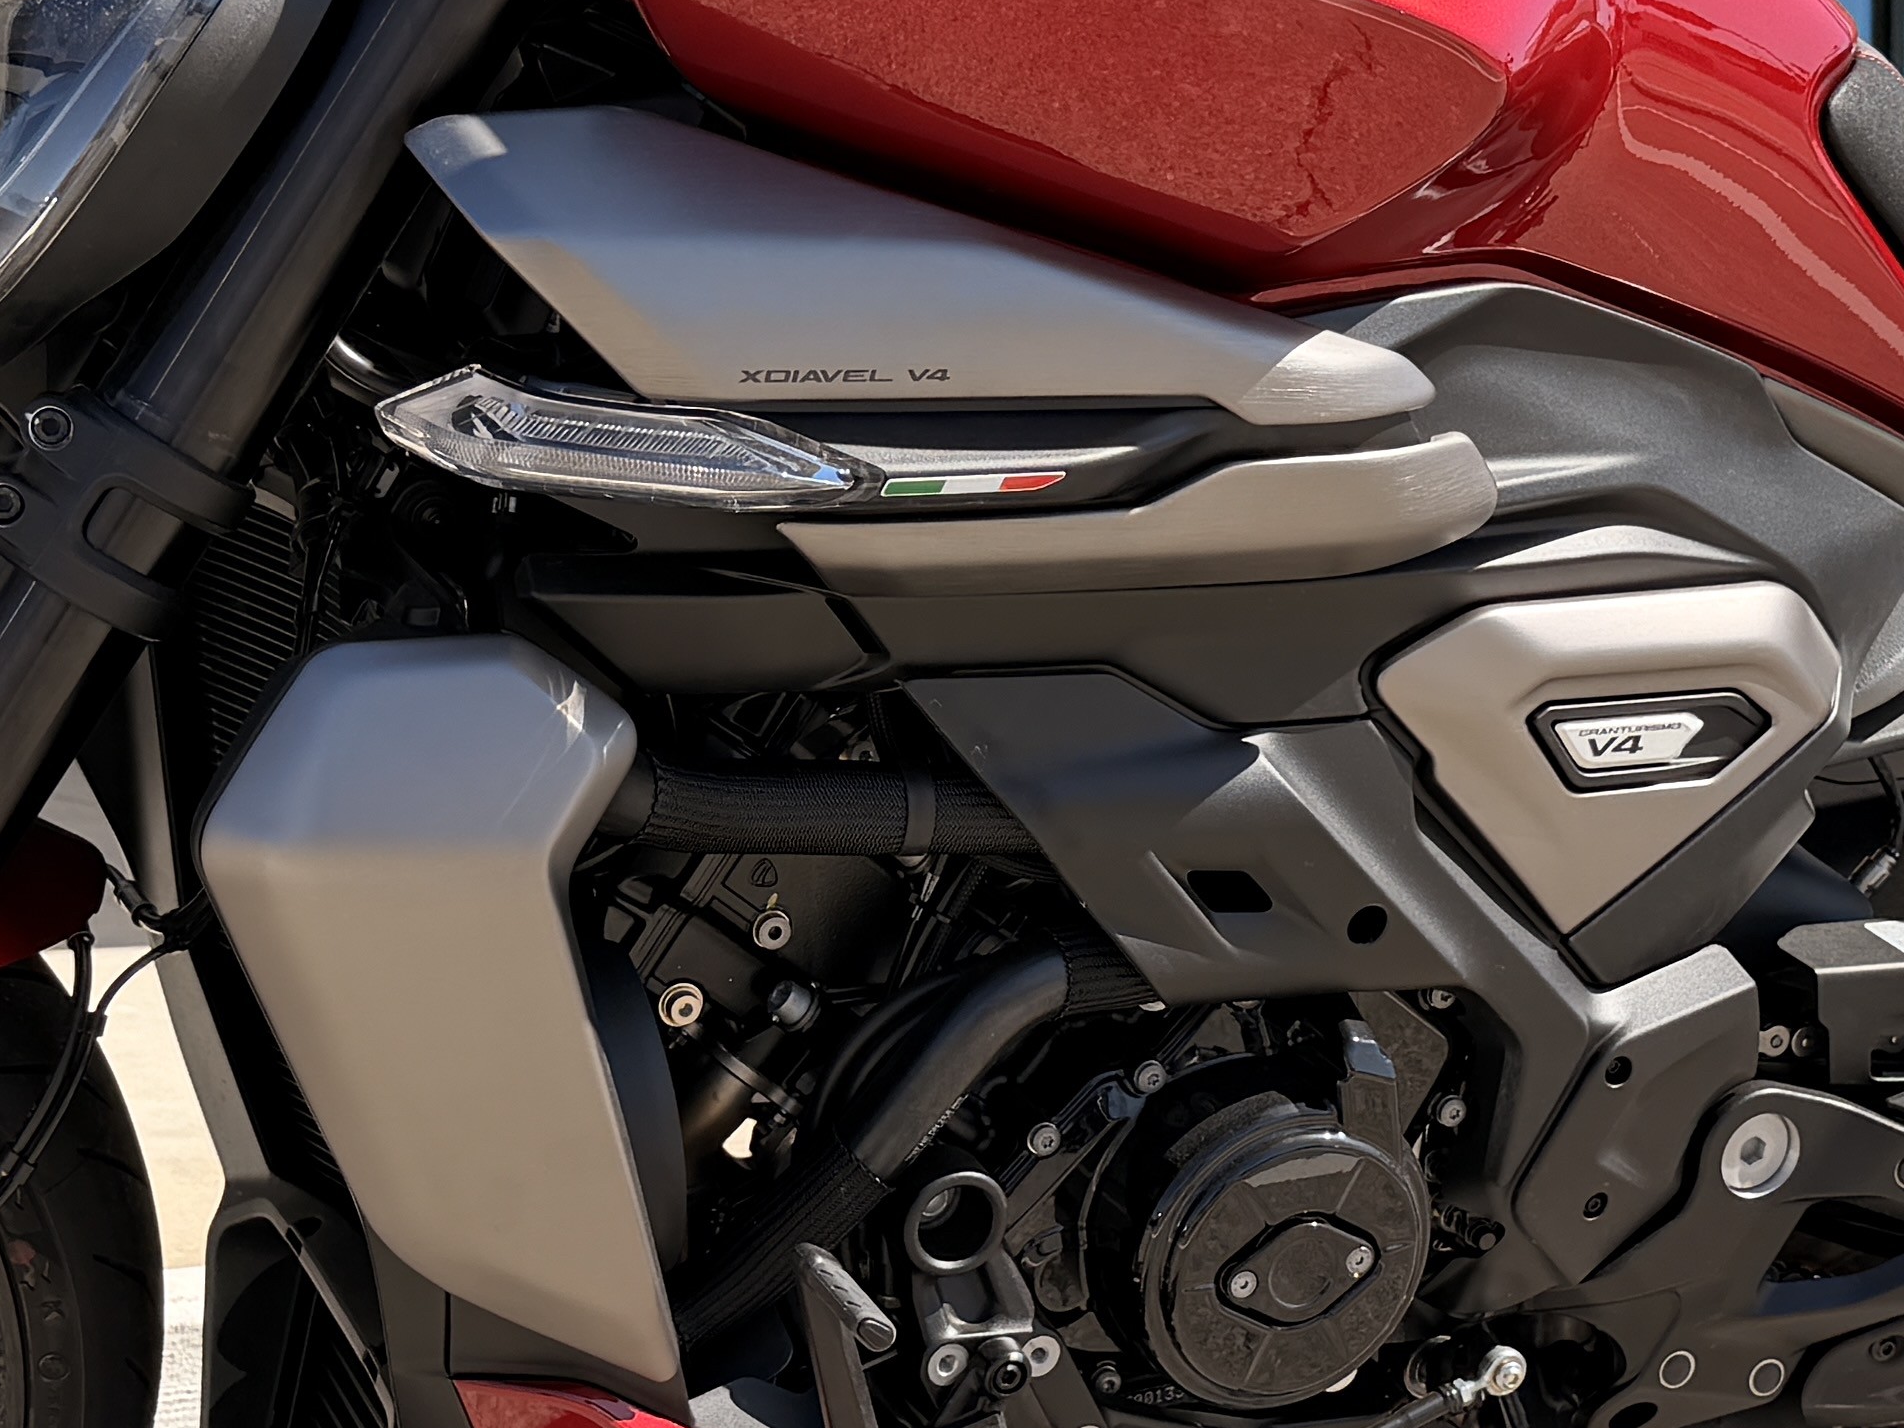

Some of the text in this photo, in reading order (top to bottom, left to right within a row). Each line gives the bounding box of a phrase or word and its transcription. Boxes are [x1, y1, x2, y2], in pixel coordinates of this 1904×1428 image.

[739, 369, 950, 383] XDIAVEL V4
[1588, 735, 1643, 757] V4
